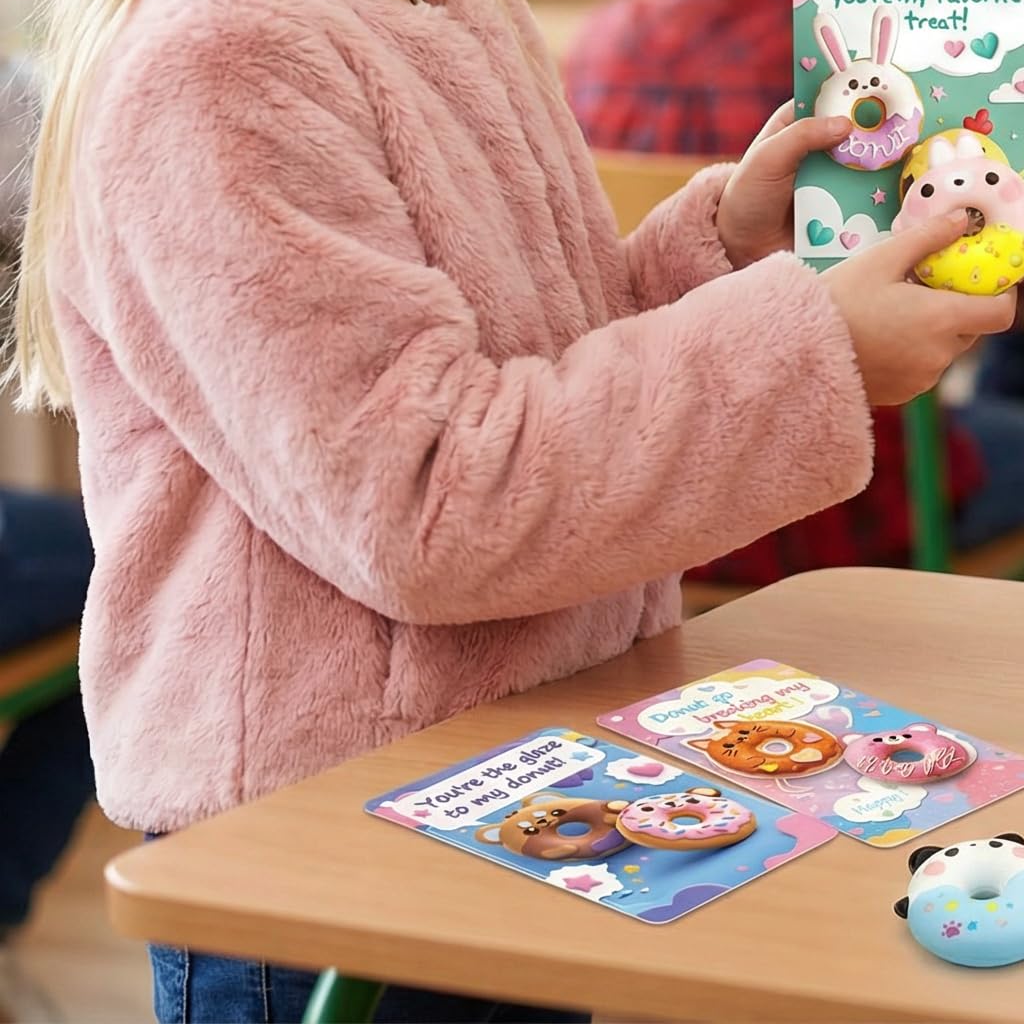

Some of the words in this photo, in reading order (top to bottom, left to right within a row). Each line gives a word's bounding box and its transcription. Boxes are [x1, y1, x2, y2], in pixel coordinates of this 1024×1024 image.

[904, 6, 969, 31] treat!
[775, 682, 811, 697] my
[647, 699, 710, 723] Donut
[414, 777, 484, 809] You're
[482, 760, 517, 779] the
[519, 739, 563, 766] glaze
[444, 805, 469, 819] to
[471, 788, 510, 806] my
[508, 756, 567, 789] donut!
